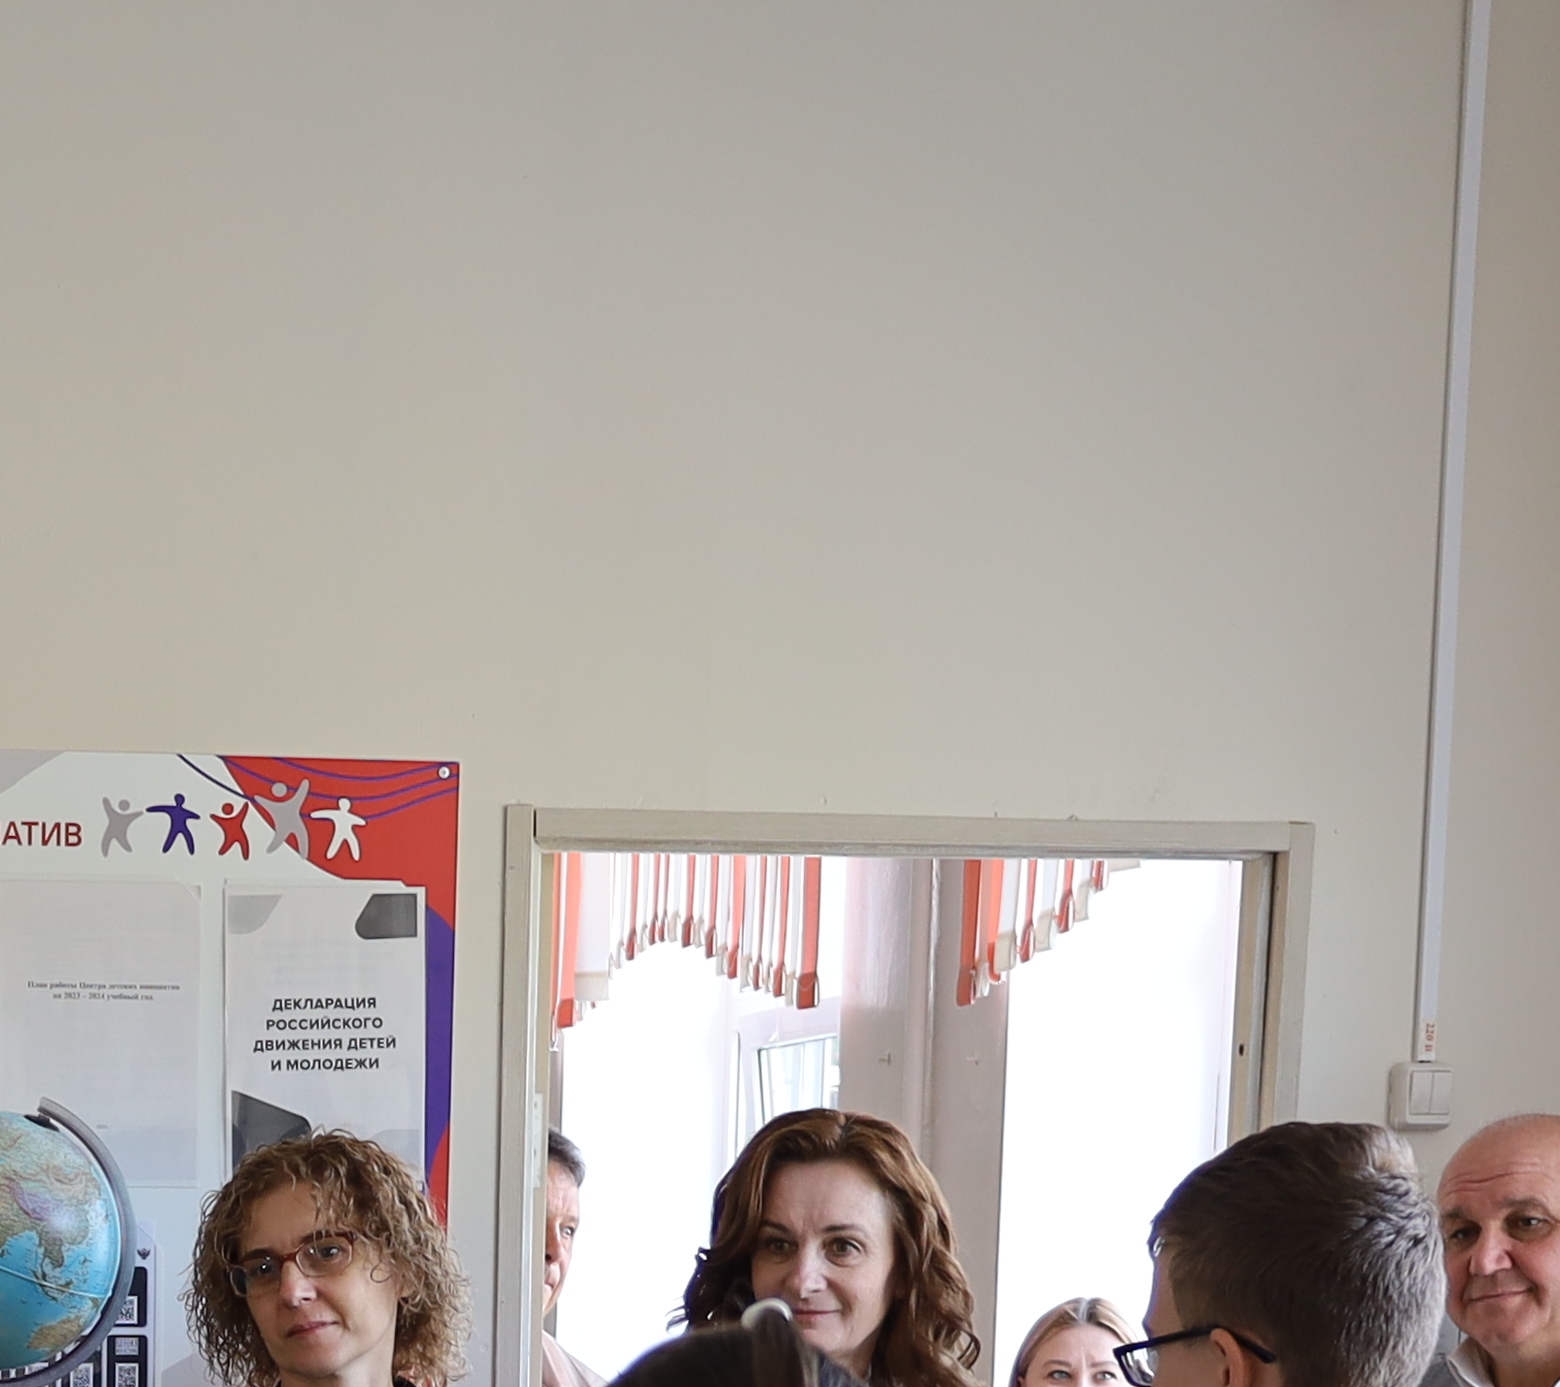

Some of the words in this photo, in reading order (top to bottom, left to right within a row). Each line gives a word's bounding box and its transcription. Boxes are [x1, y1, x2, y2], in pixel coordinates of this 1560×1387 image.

[272, 997, 377, 1012] ДЕКЛАРАЦИЯ
[266, 1016, 383, 1031] РОССИЙСКОГО
[253, 1038, 342, 1053] ДВИЖЕНИЯ
[347, 1035, 396, 1051] ДЕТЕЙ
[271, 1059, 281, 1071] И
[286, 1057, 379, 1071] МОЛОДЕЖИ
